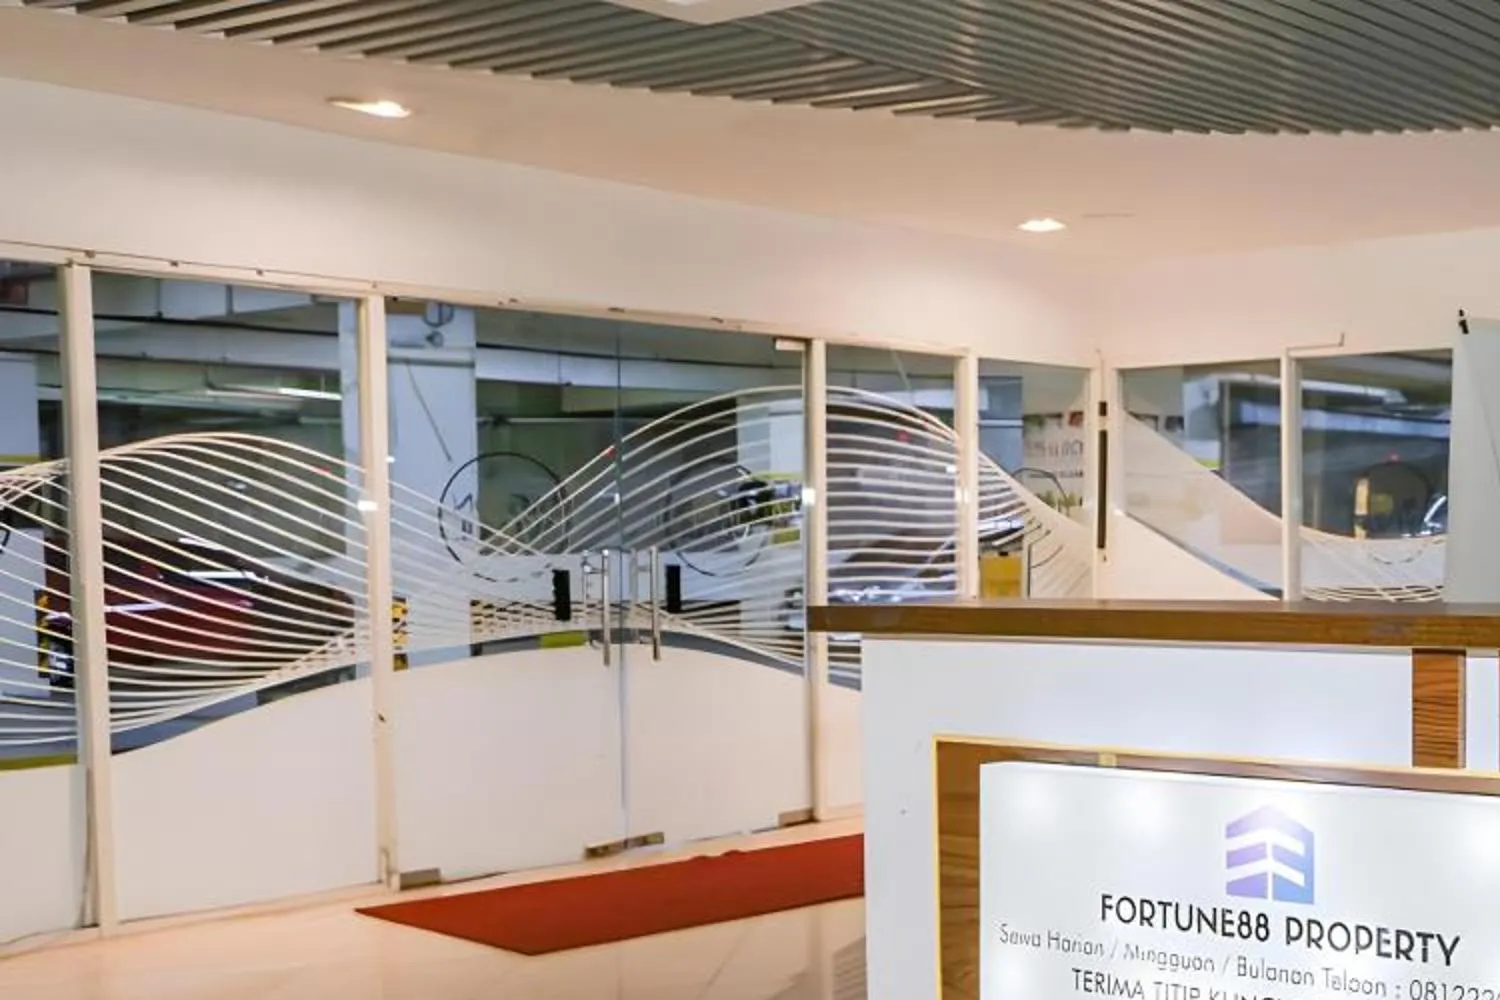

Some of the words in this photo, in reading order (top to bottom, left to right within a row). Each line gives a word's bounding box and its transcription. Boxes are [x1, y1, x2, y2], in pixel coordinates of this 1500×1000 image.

[1101, 893, 1270, 942] FORTUNE88
[1285, 915, 1461, 967] PROPERTY
[1071, 967, 1145, 1000] TERIMA
[1237, 955, 1315, 987] Bulanan
